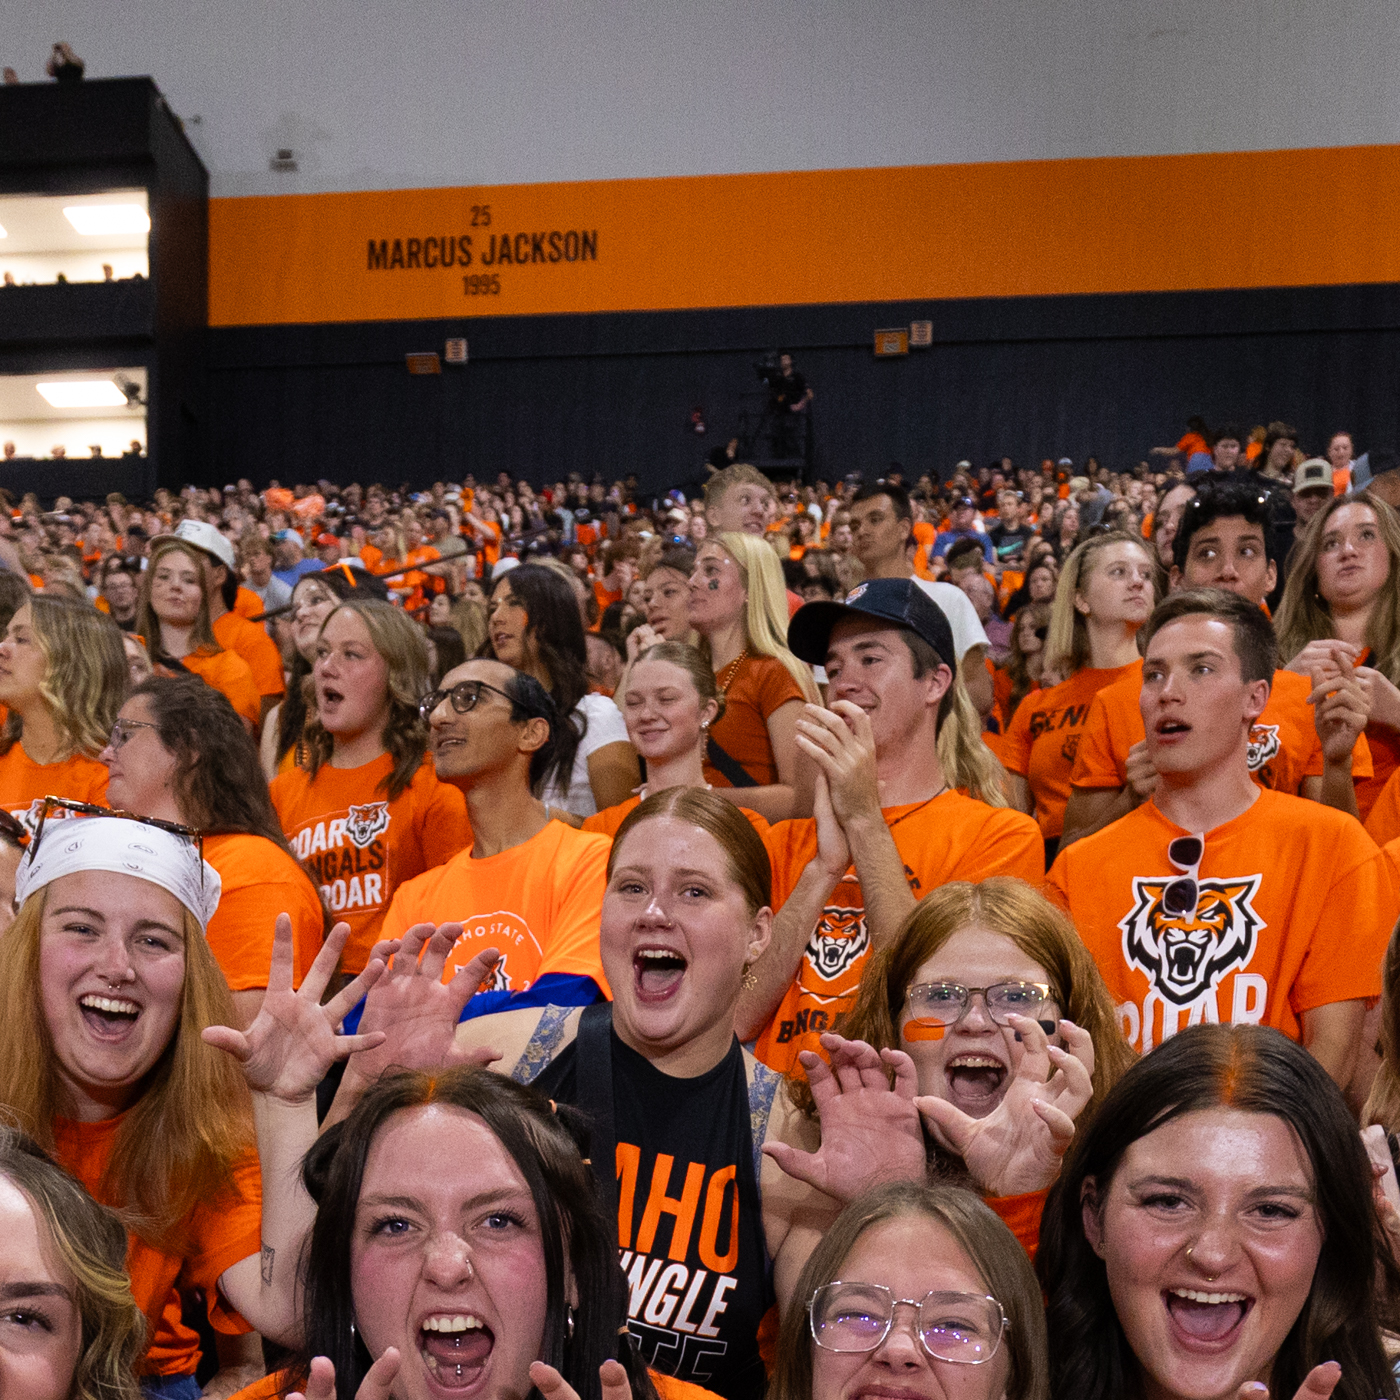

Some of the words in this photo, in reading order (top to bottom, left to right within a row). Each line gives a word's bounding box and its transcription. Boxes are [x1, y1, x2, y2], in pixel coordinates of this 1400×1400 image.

[470, 205, 491, 227] 25
[367, 235, 472, 271] MARCUS
[481, 229, 598, 266] JACKSON
[462, 273, 500, 296] 1995
[490, 922, 525, 946] STATE
[620, 1250, 738, 1337] NGLE
